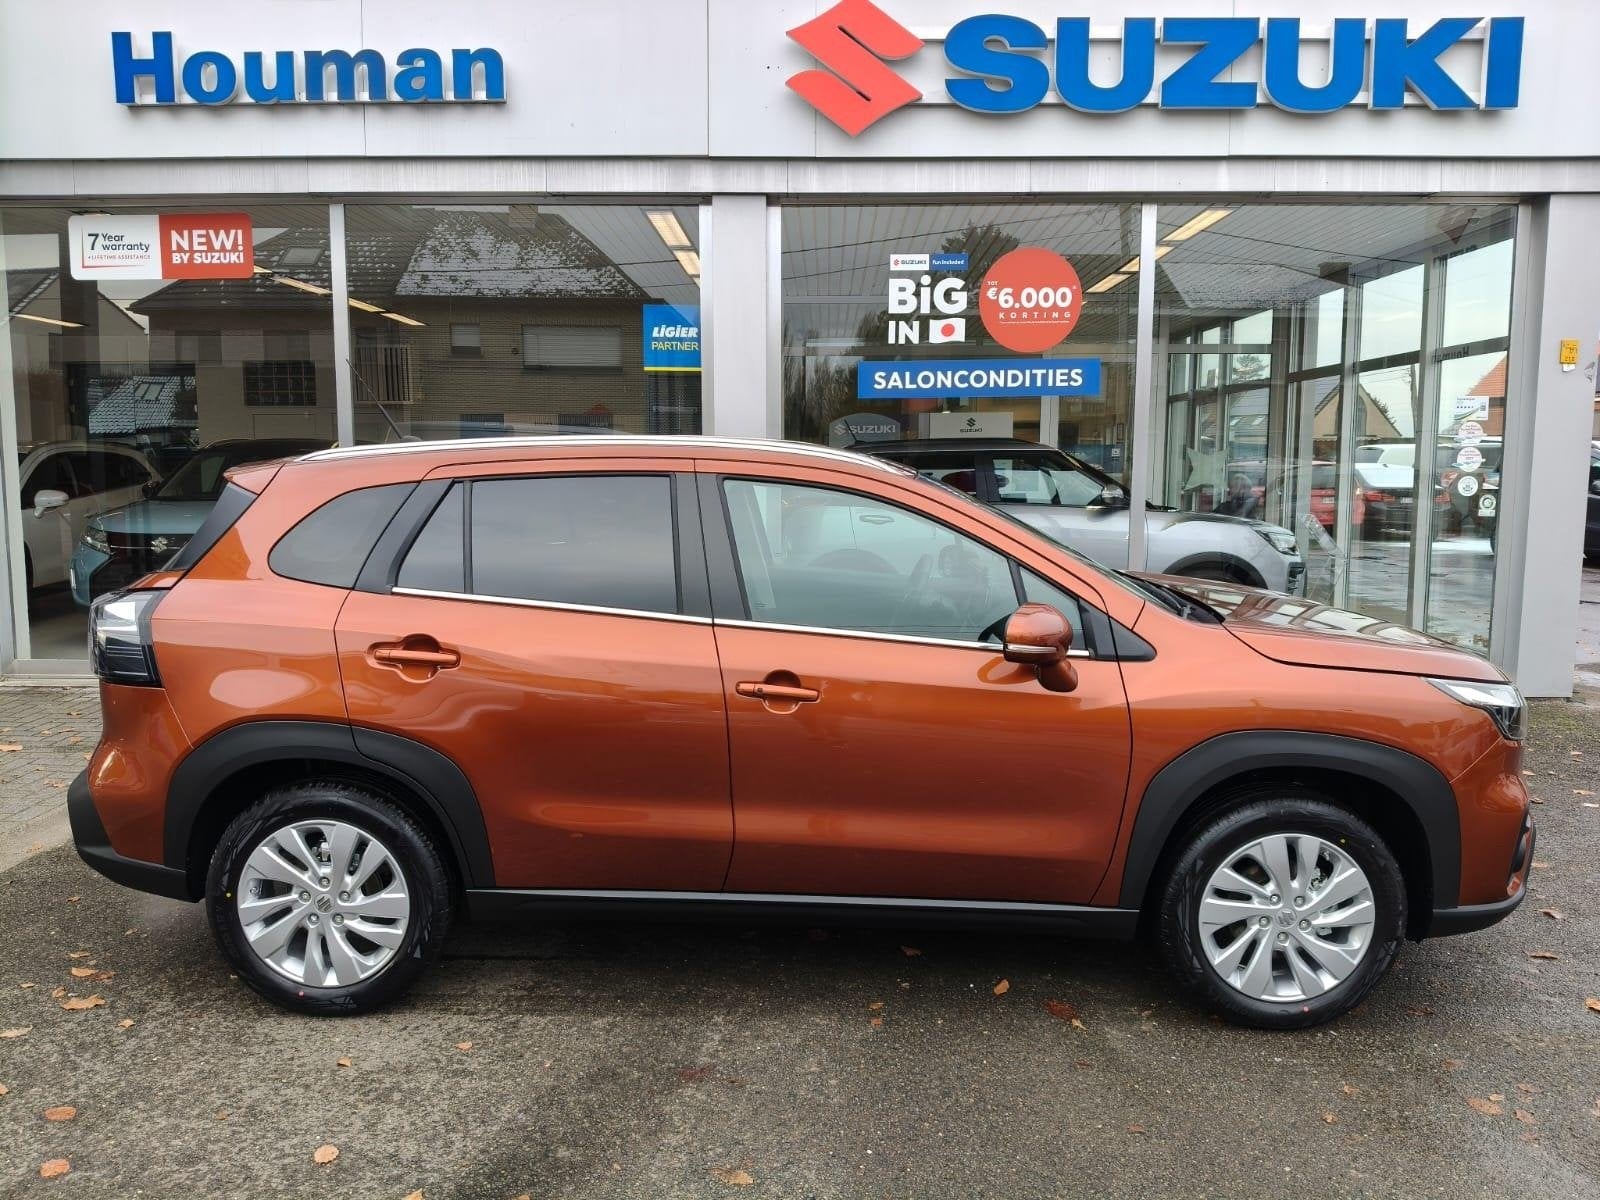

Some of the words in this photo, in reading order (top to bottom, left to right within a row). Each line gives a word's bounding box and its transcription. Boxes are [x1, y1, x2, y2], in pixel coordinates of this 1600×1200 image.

[111, 31, 505, 106] Houman
[944, 13, 1526, 113] SUZUKI
[87, 233, 100, 251] 7
[101, 232, 125, 242] Year
[171, 229, 244, 251] NEW!
[101, 242, 150, 253] warranty
[172, 252, 189, 264] BY
[193, 252, 244, 264] SUZUKI
[888, 274, 968, 315] BiG
[999, 311, 1071, 319] KORTING
[888, 320, 920, 345] IN
[651, 341, 700, 351] PARTNER
[873, 368, 1083, 390] SALONCONDITIES
[849, 424, 896, 434] SUZUKI
